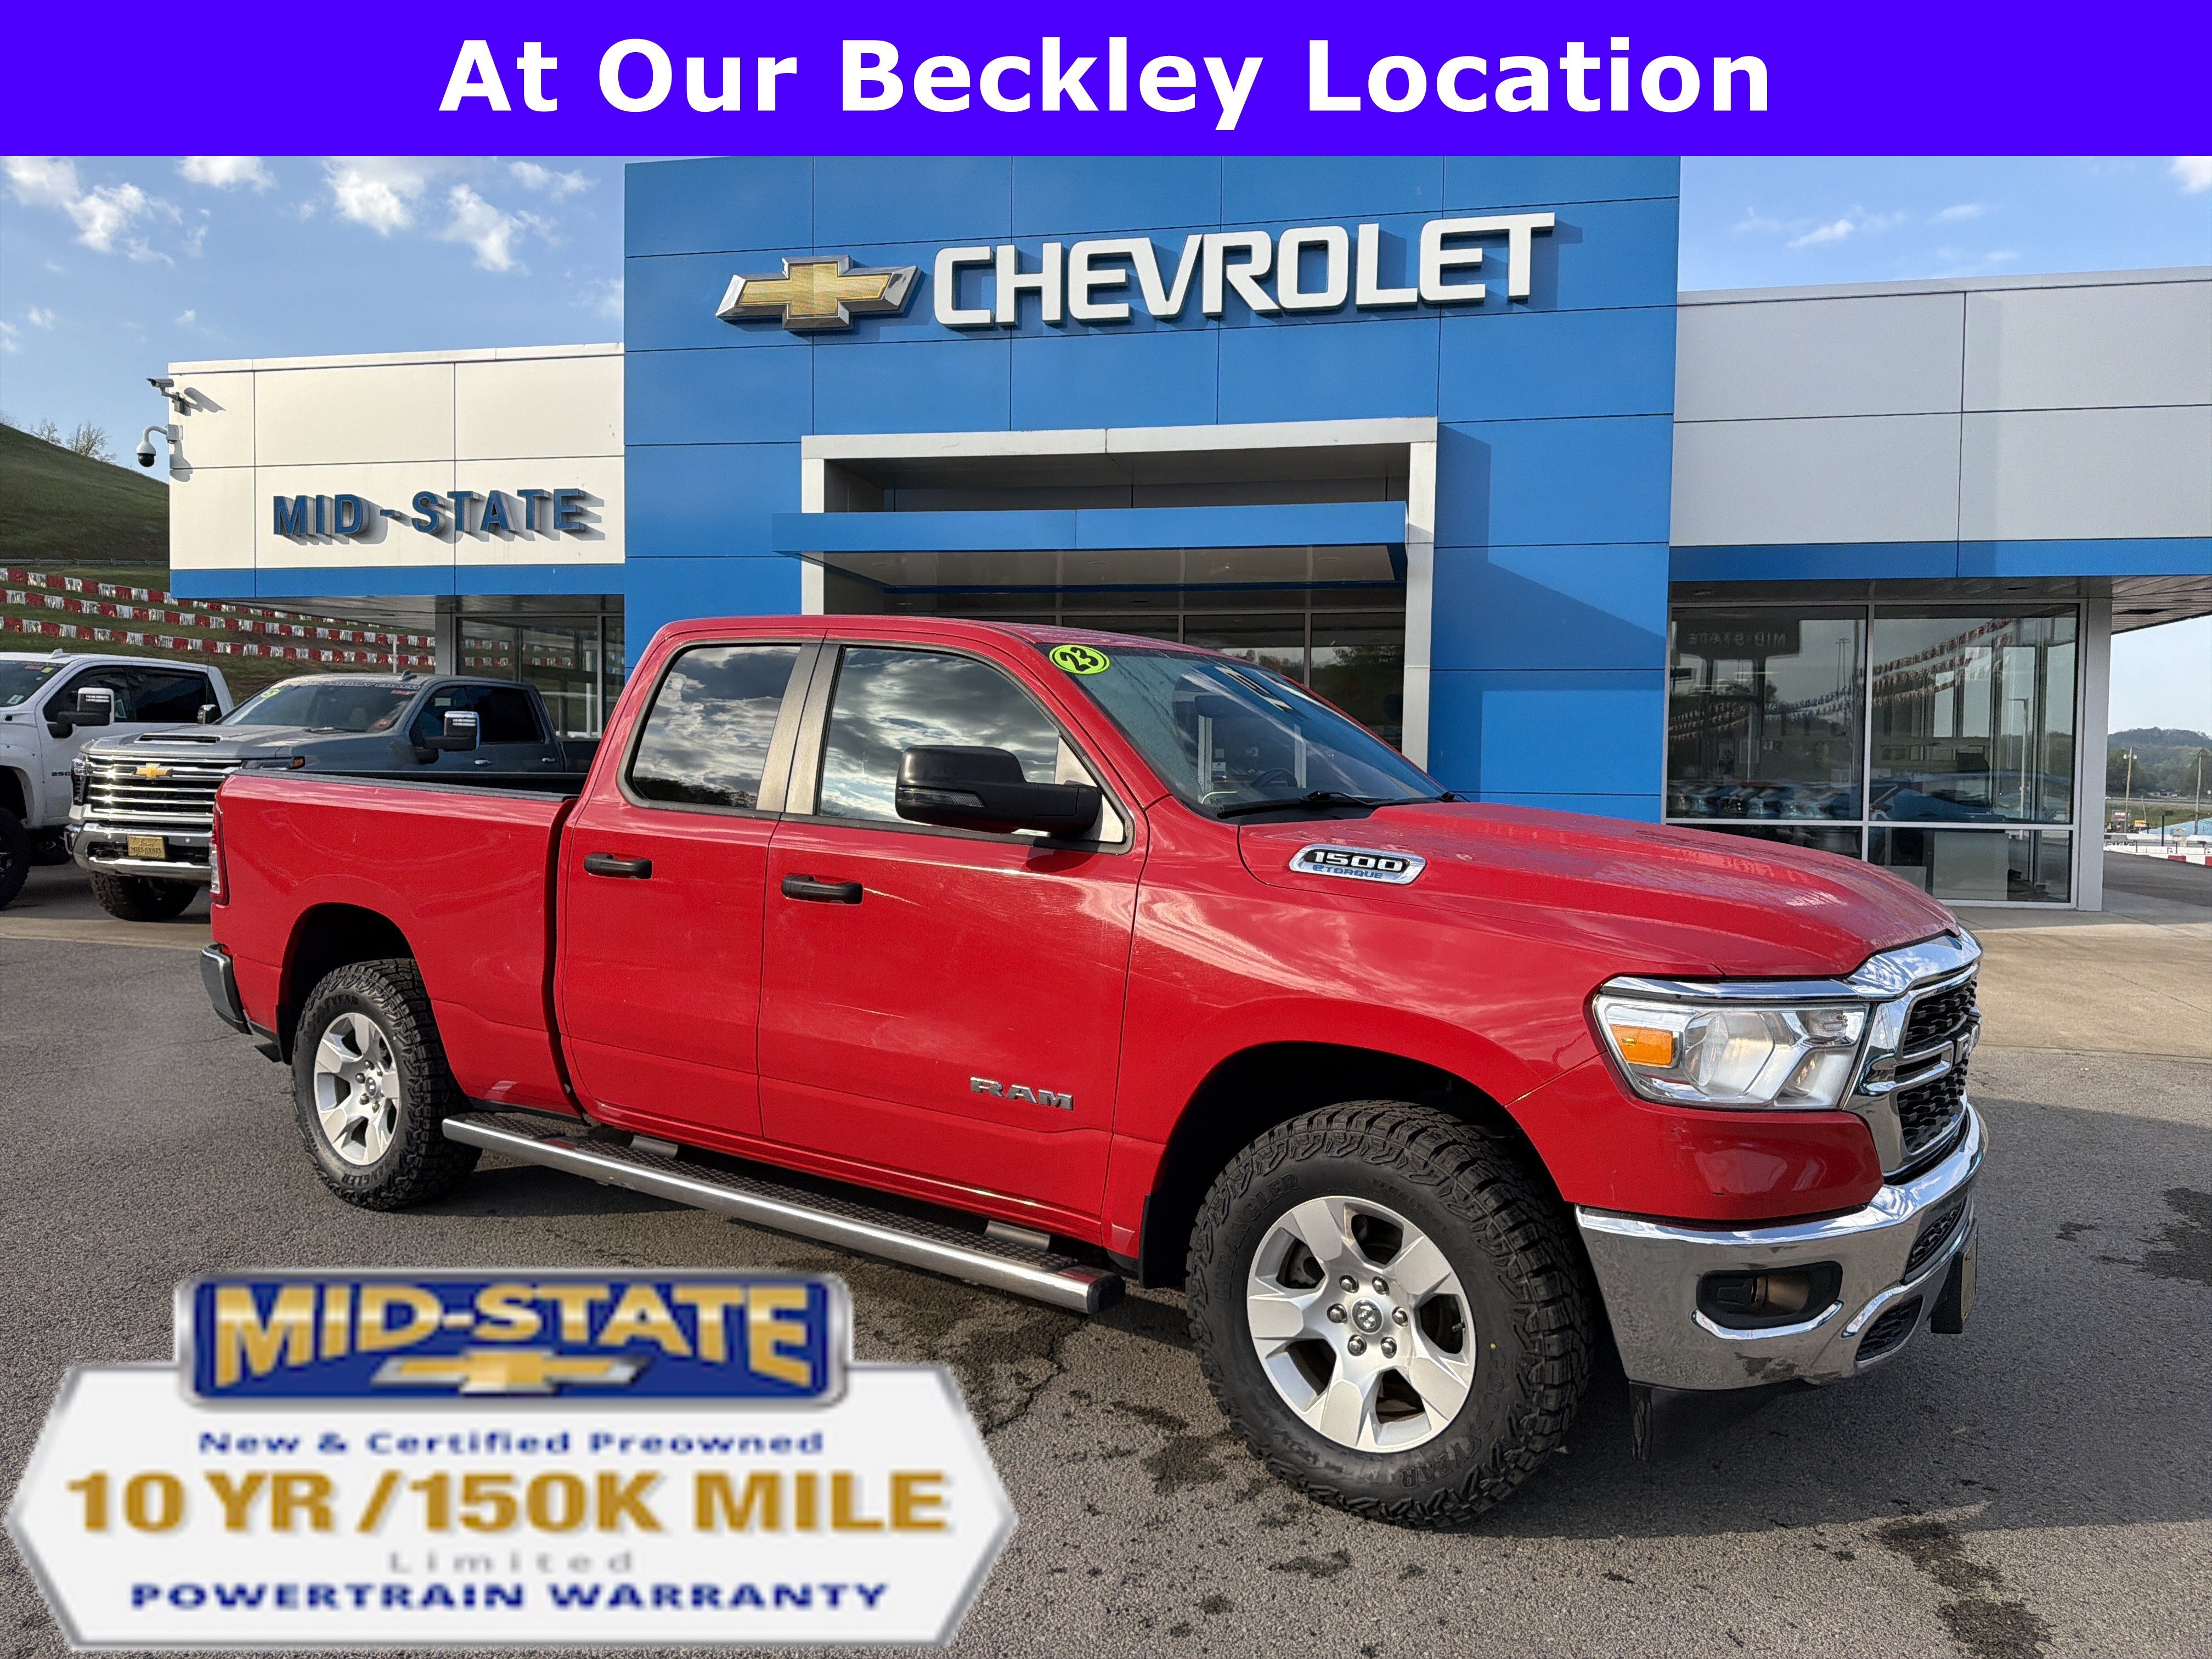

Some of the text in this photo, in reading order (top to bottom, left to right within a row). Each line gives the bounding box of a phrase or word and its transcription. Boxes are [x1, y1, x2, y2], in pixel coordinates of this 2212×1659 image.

[933, 212, 1556, 328] CHEVROLET
[273, 488, 587, 536] MID-STATE
[1059, 646, 1099, 672] 23
[1313, 851, 1403, 872] 1500
[970, 1076, 1074, 1111] RAM
